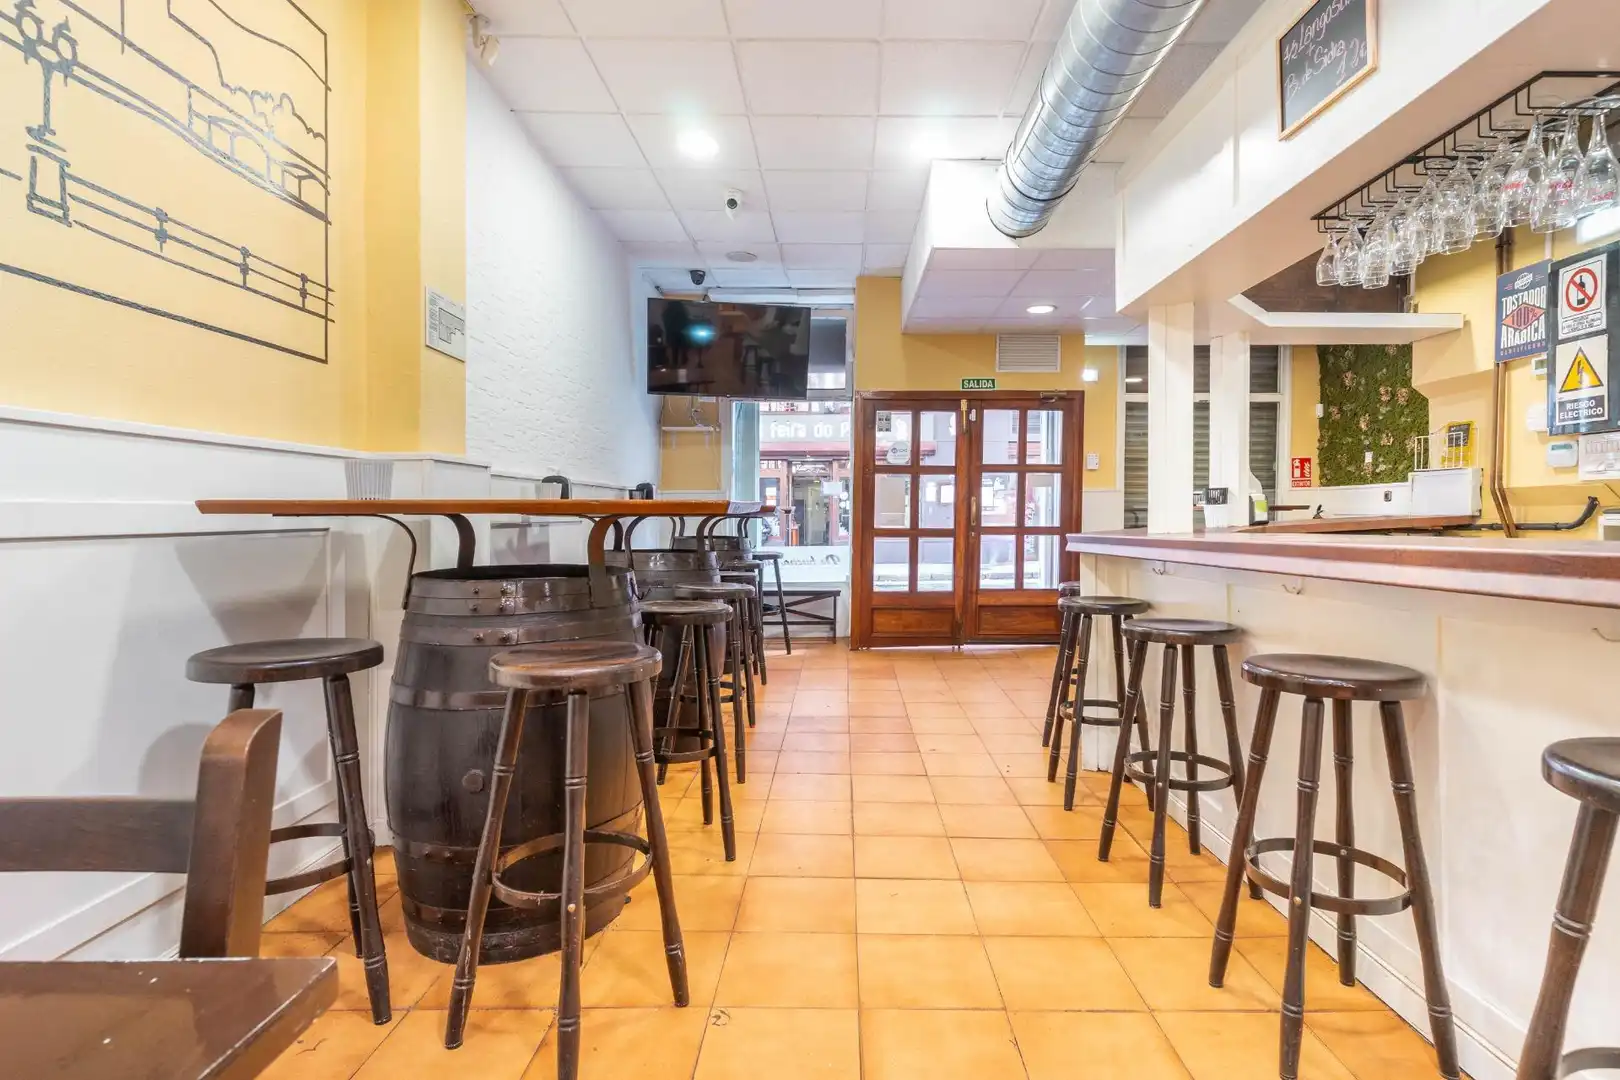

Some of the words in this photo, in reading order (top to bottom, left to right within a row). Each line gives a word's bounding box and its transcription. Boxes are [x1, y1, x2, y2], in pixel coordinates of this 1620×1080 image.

[1502, 285, 1546, 318] TOSTADOR
[1511, 305, 1538, 328] 100%
[963, 379, 994, 389] SALIDA
[1566, 399, 1596, 411] RIESGO
[1559, 407, 1603, 419] ELECTRICO
[813, 421, 833, 438] do
